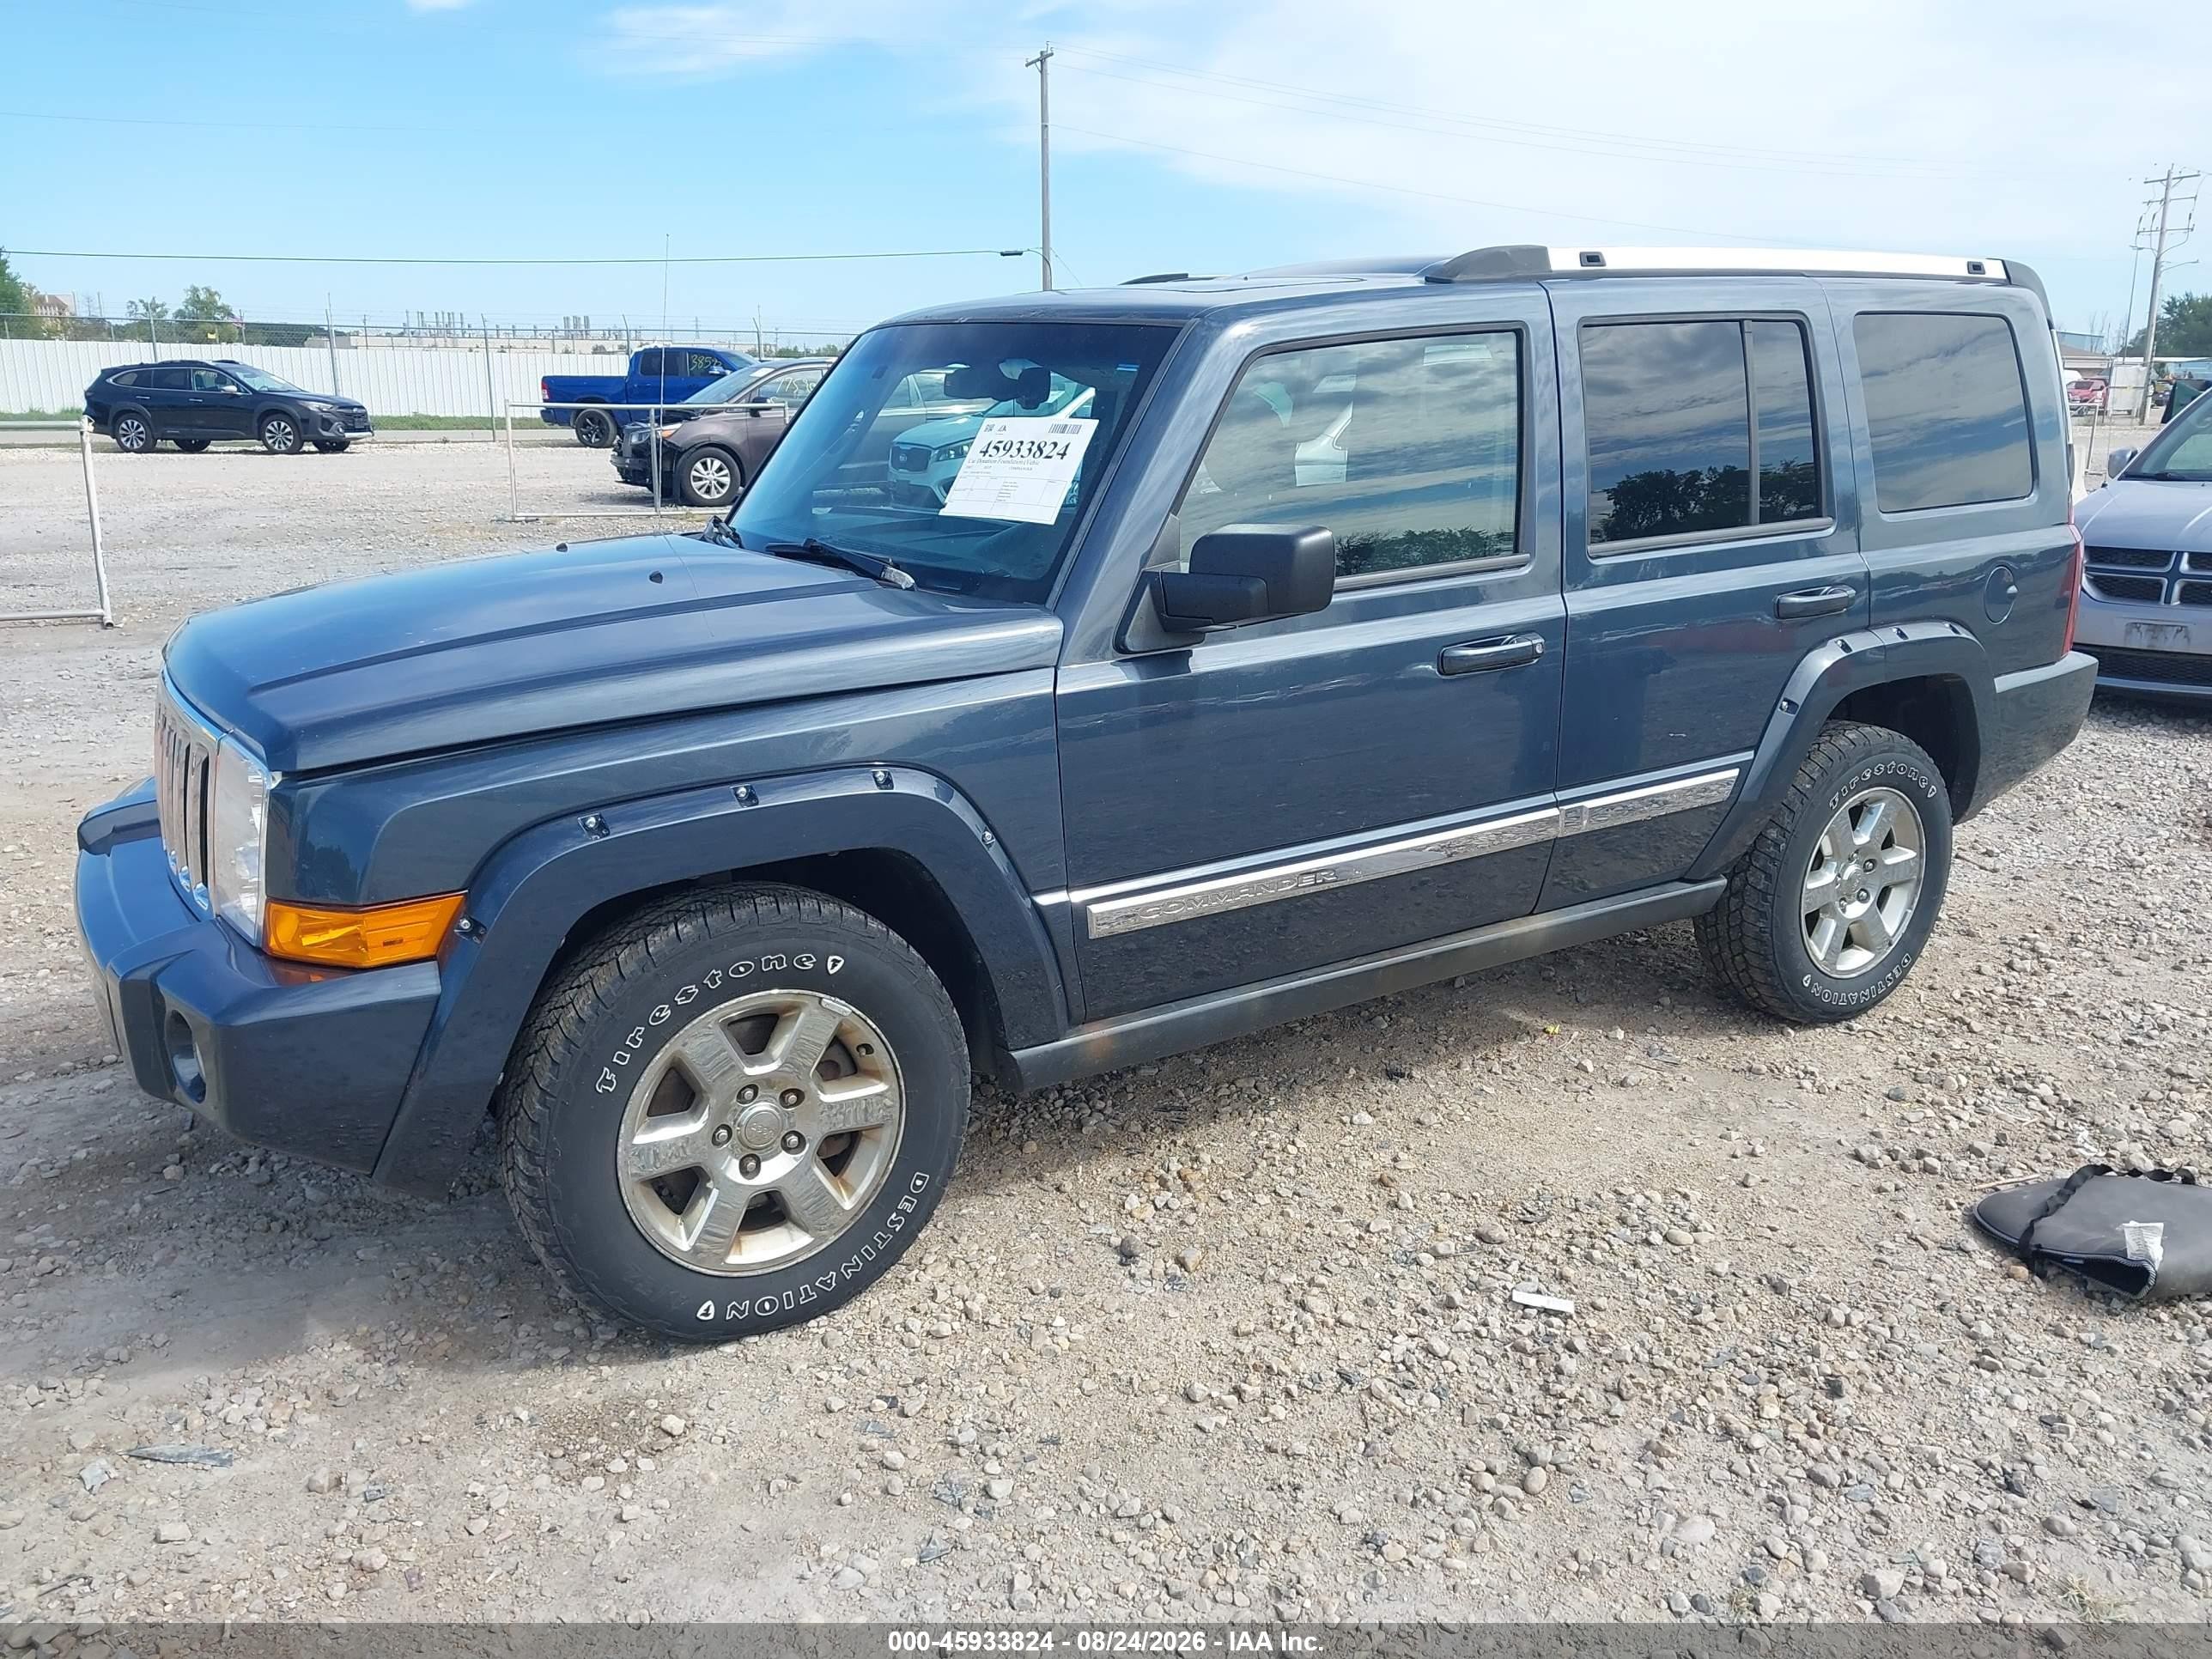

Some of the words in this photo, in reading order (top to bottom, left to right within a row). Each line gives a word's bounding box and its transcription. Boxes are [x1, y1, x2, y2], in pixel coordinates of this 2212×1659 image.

[979, 440, 1071, 459] 45933824
[1829, 761, 1929, 811] Firestone
[1139, 868, 1340, 919] COMMANDER
[1810, 953, 1912, 1006] DESTINATION
[595, 952, 817, 1094] Firestone
[725, 1171, 931, 1322] DESTINATION
